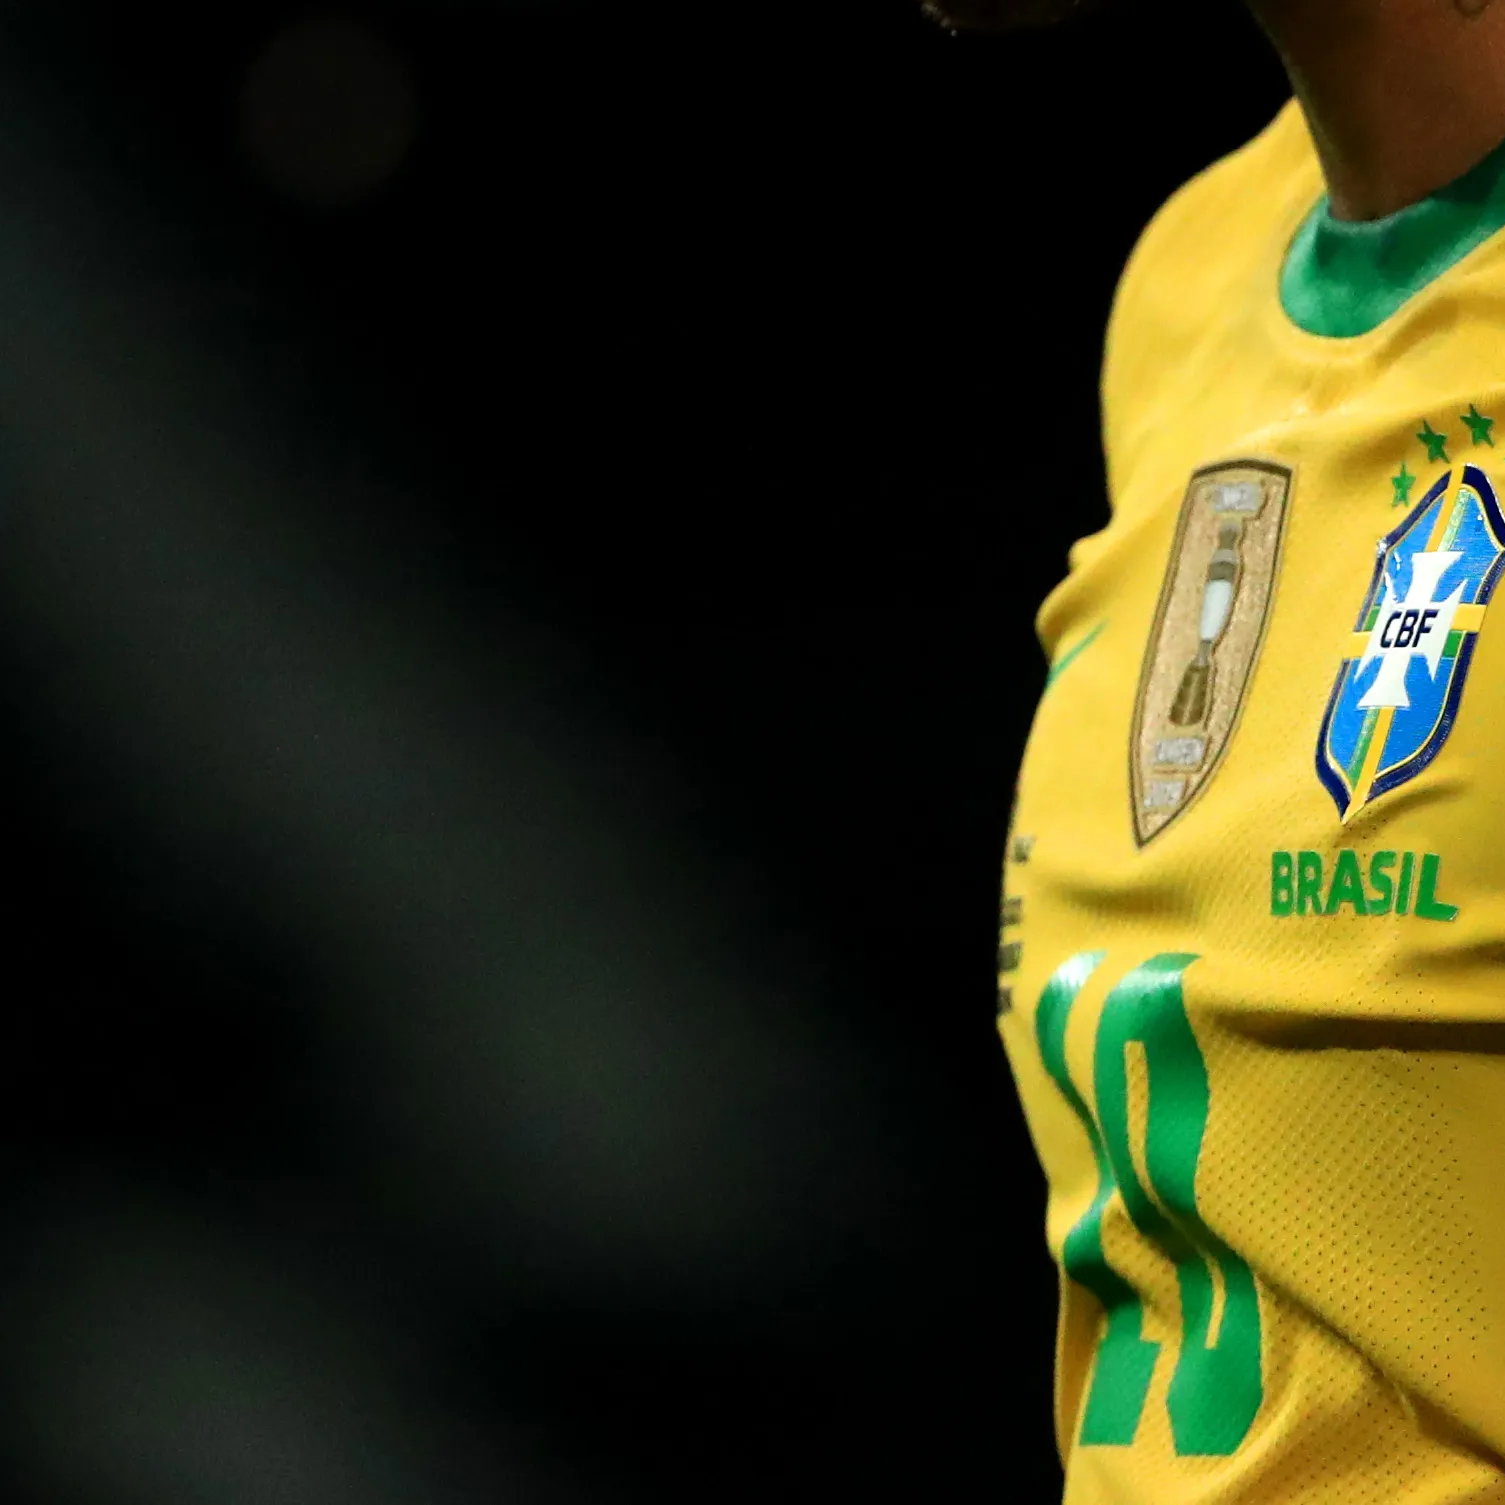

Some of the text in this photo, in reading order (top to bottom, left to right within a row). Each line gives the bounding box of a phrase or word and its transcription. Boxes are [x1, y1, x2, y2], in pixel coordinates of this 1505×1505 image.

[1379, 608, 1438, 648] CBF
[1270, 850, 1459, 922] BRASIL
[1034, 949, 1264, 1457] 10
